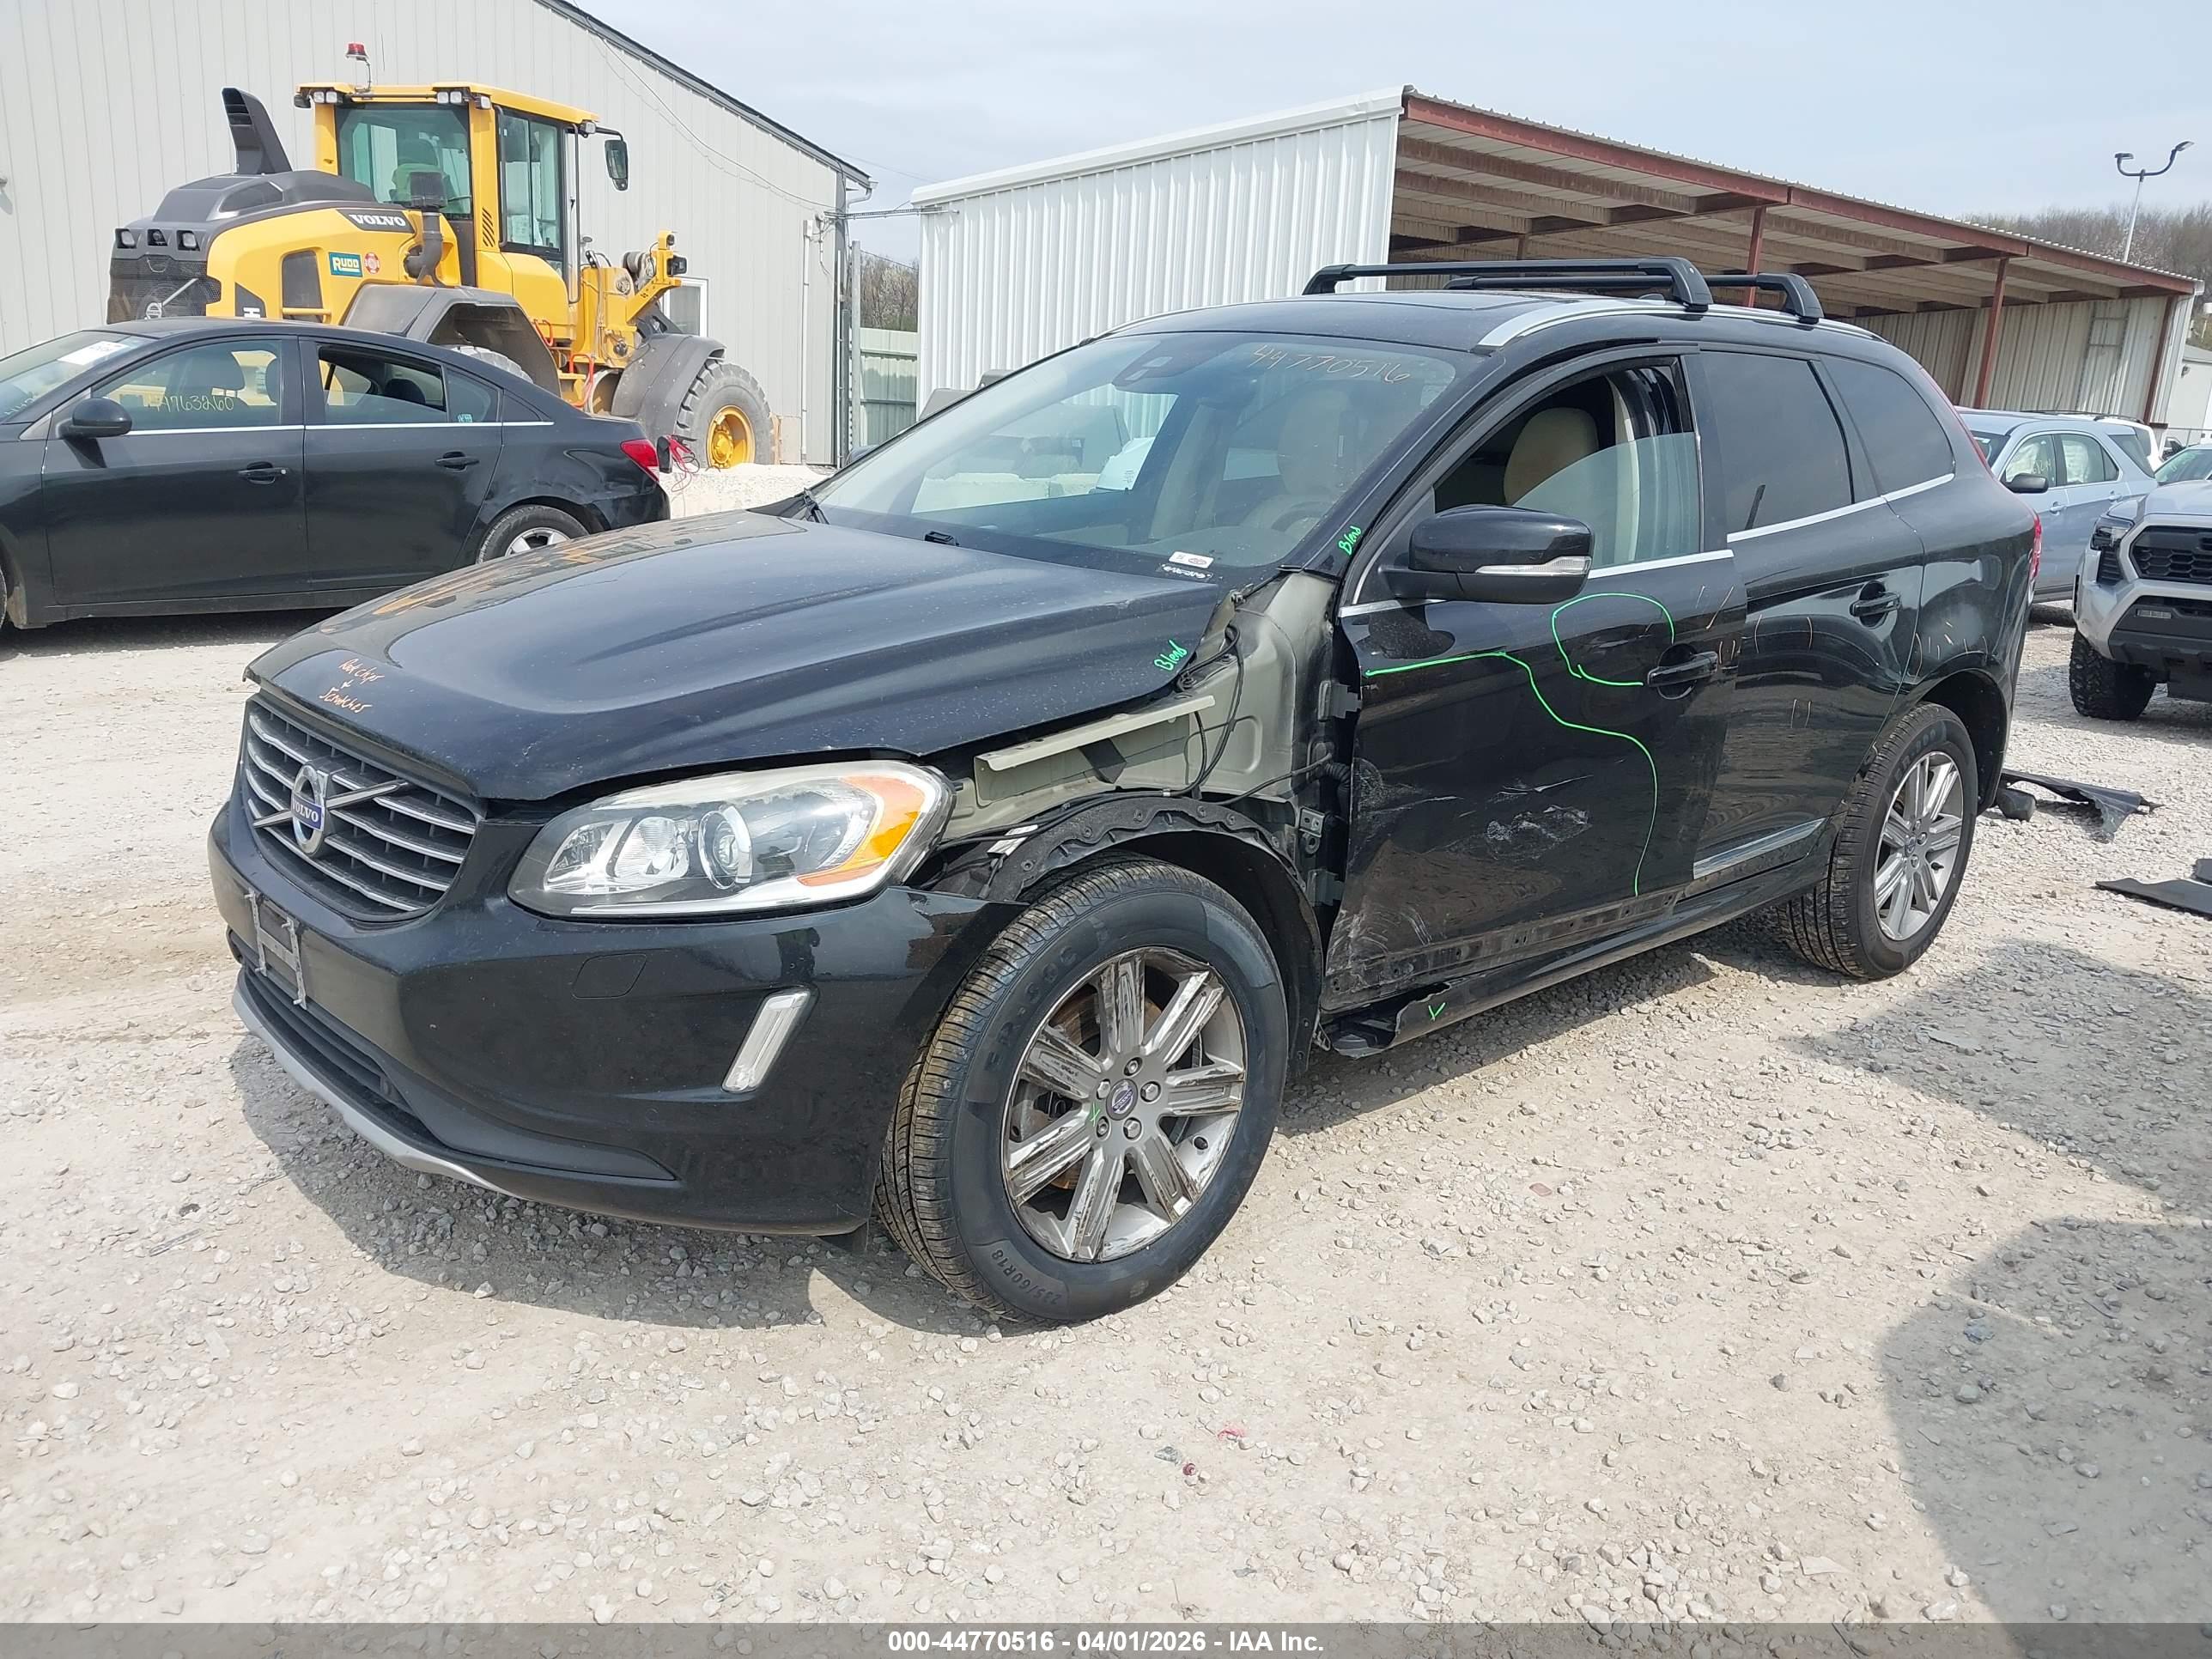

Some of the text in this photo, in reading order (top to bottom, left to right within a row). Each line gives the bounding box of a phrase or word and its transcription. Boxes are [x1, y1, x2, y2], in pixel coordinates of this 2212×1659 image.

[349, 213, 406, 227] VOLVO
[331, 257, 360, 271] RUDD
[1246, 344, 1411, 384] 44770516
[1338, 525, 1362, 556] Blend
[1153, 639, 1188, 671] Blend
[292, 798, 319, 823] VOLVO
[991, 1249, 1063, 1305] 235/60R18
